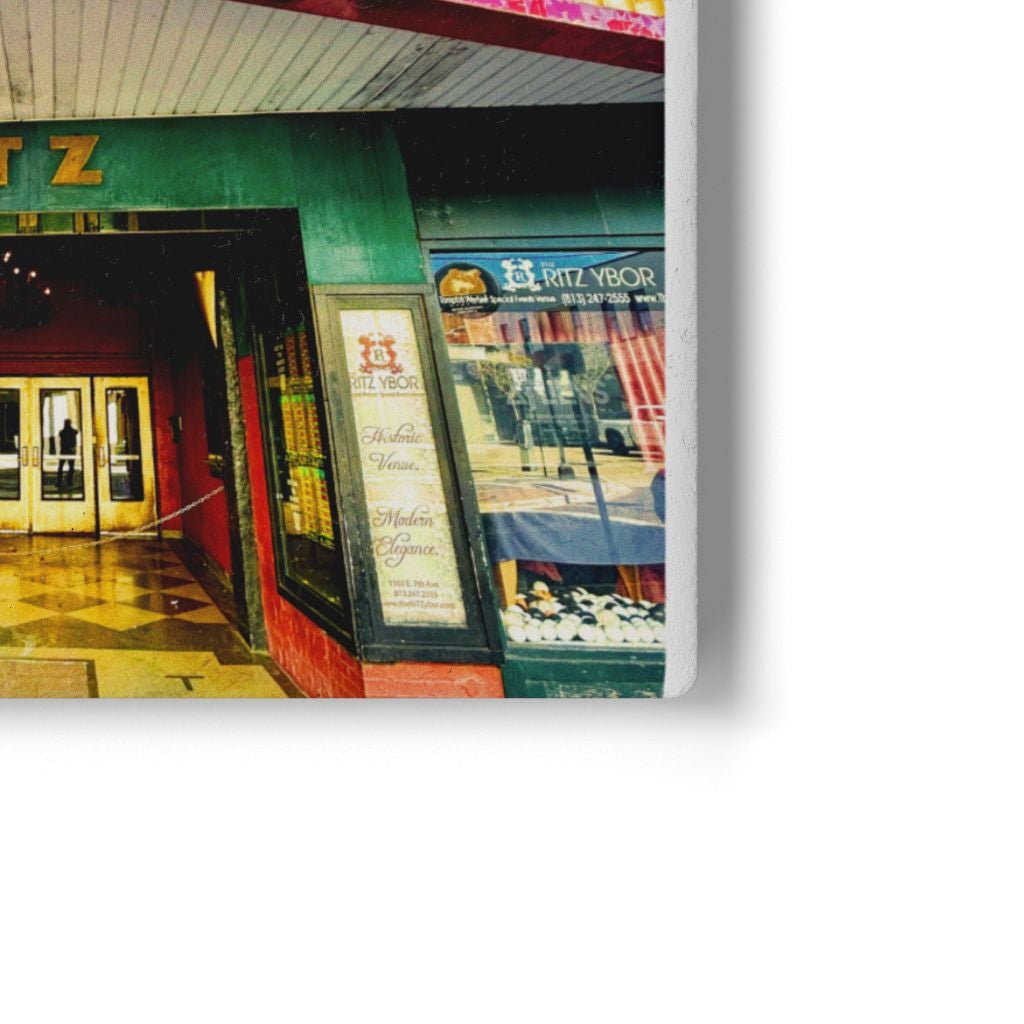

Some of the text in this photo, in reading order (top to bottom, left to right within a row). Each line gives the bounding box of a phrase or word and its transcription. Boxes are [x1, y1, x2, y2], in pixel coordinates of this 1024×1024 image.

[543, 266, 656, 288] RITZ YBOR
[350, 375, 419, 390] RITZ YBOR
[361, 423, 422, 444] Historic
[372, 505, 434, 528] Modern
